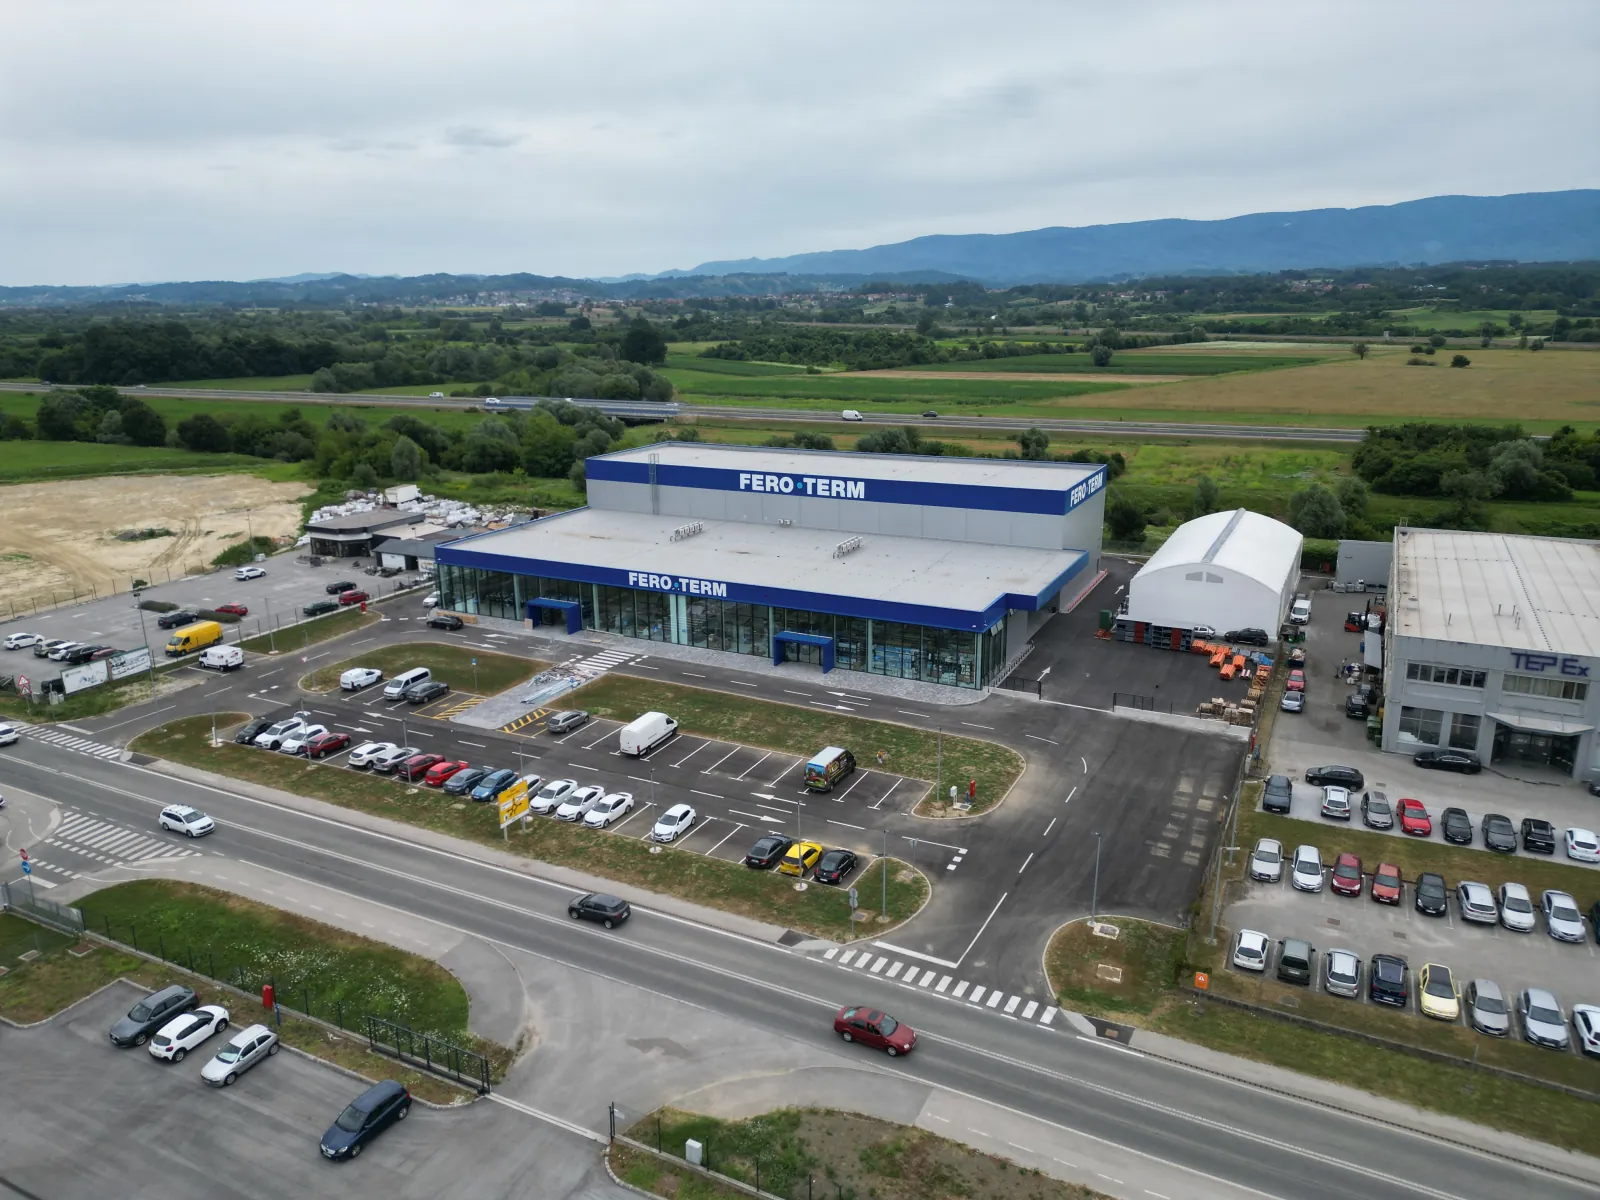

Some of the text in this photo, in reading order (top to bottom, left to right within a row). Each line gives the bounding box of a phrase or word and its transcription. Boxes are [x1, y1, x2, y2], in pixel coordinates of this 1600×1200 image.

[739, 473, 865, 499] FERO TERM
[1070, 482, 1087, 507] FERO
[628, 571, 727, 597] FERO TERM
[1511, 652, 1558, 672] TEP
